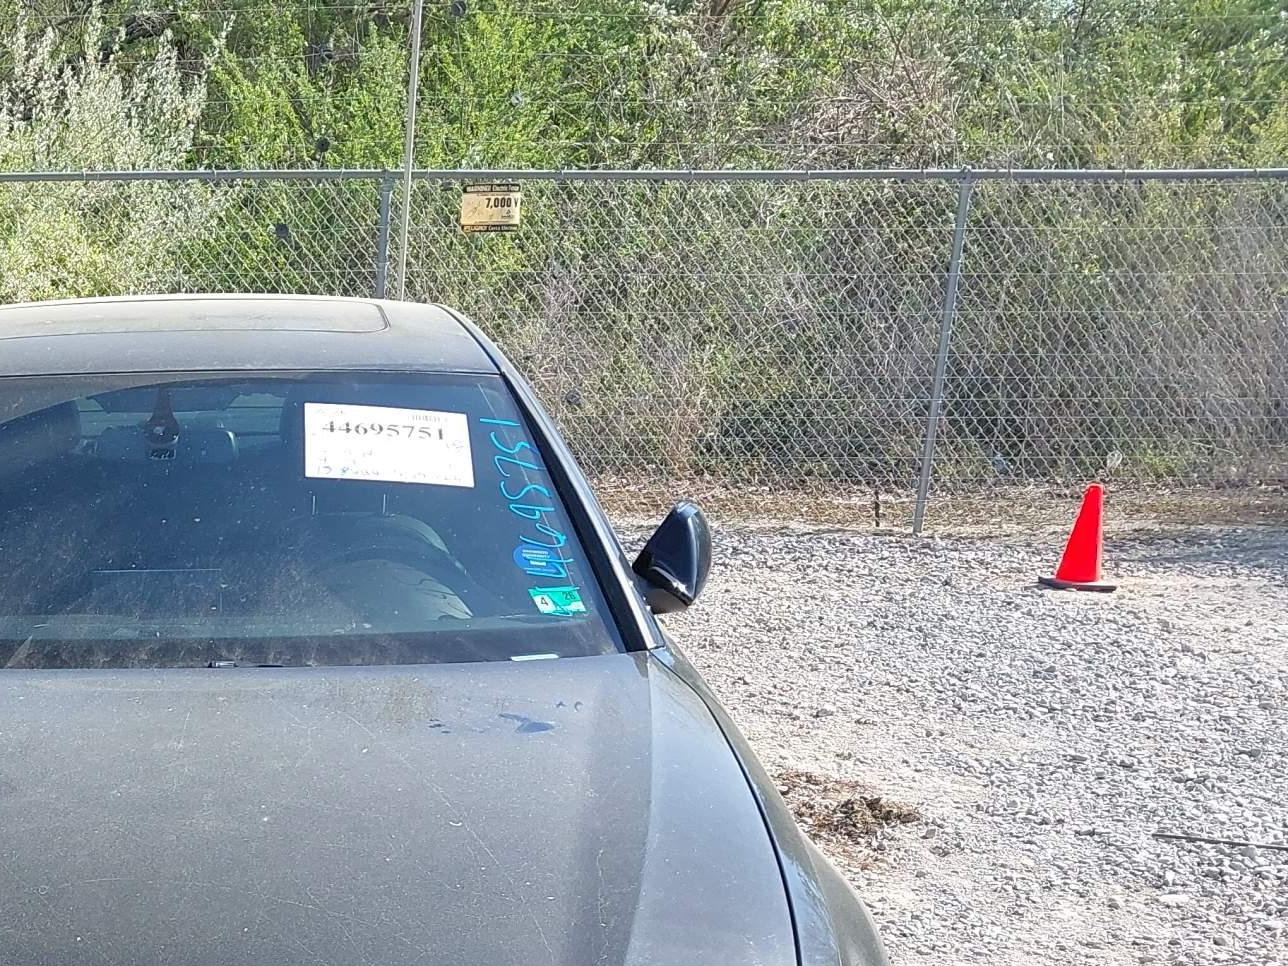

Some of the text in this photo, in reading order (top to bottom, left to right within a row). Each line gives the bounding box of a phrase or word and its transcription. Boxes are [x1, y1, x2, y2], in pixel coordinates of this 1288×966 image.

[485, 197, 519, 209] 7,000 V
[321, 419, 444, 441] 44695751
